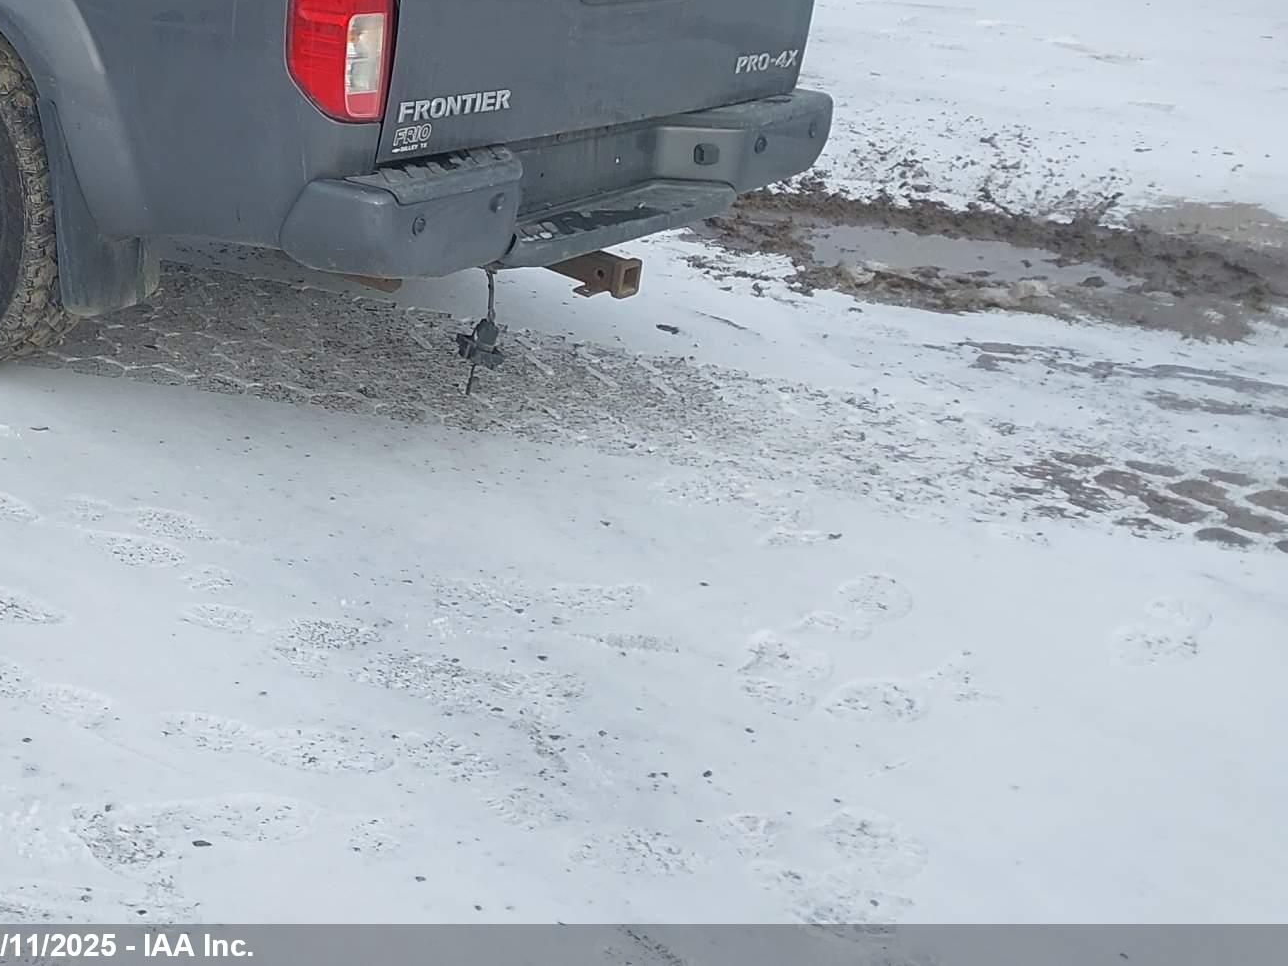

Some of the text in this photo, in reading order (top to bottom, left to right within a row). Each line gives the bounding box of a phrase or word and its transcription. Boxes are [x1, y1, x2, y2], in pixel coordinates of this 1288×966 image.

[735, 49, 799, 74] PRO-4X
[398, 89, 512, 123] FRONTIER
[393, 124, 432, 146] FRIO
